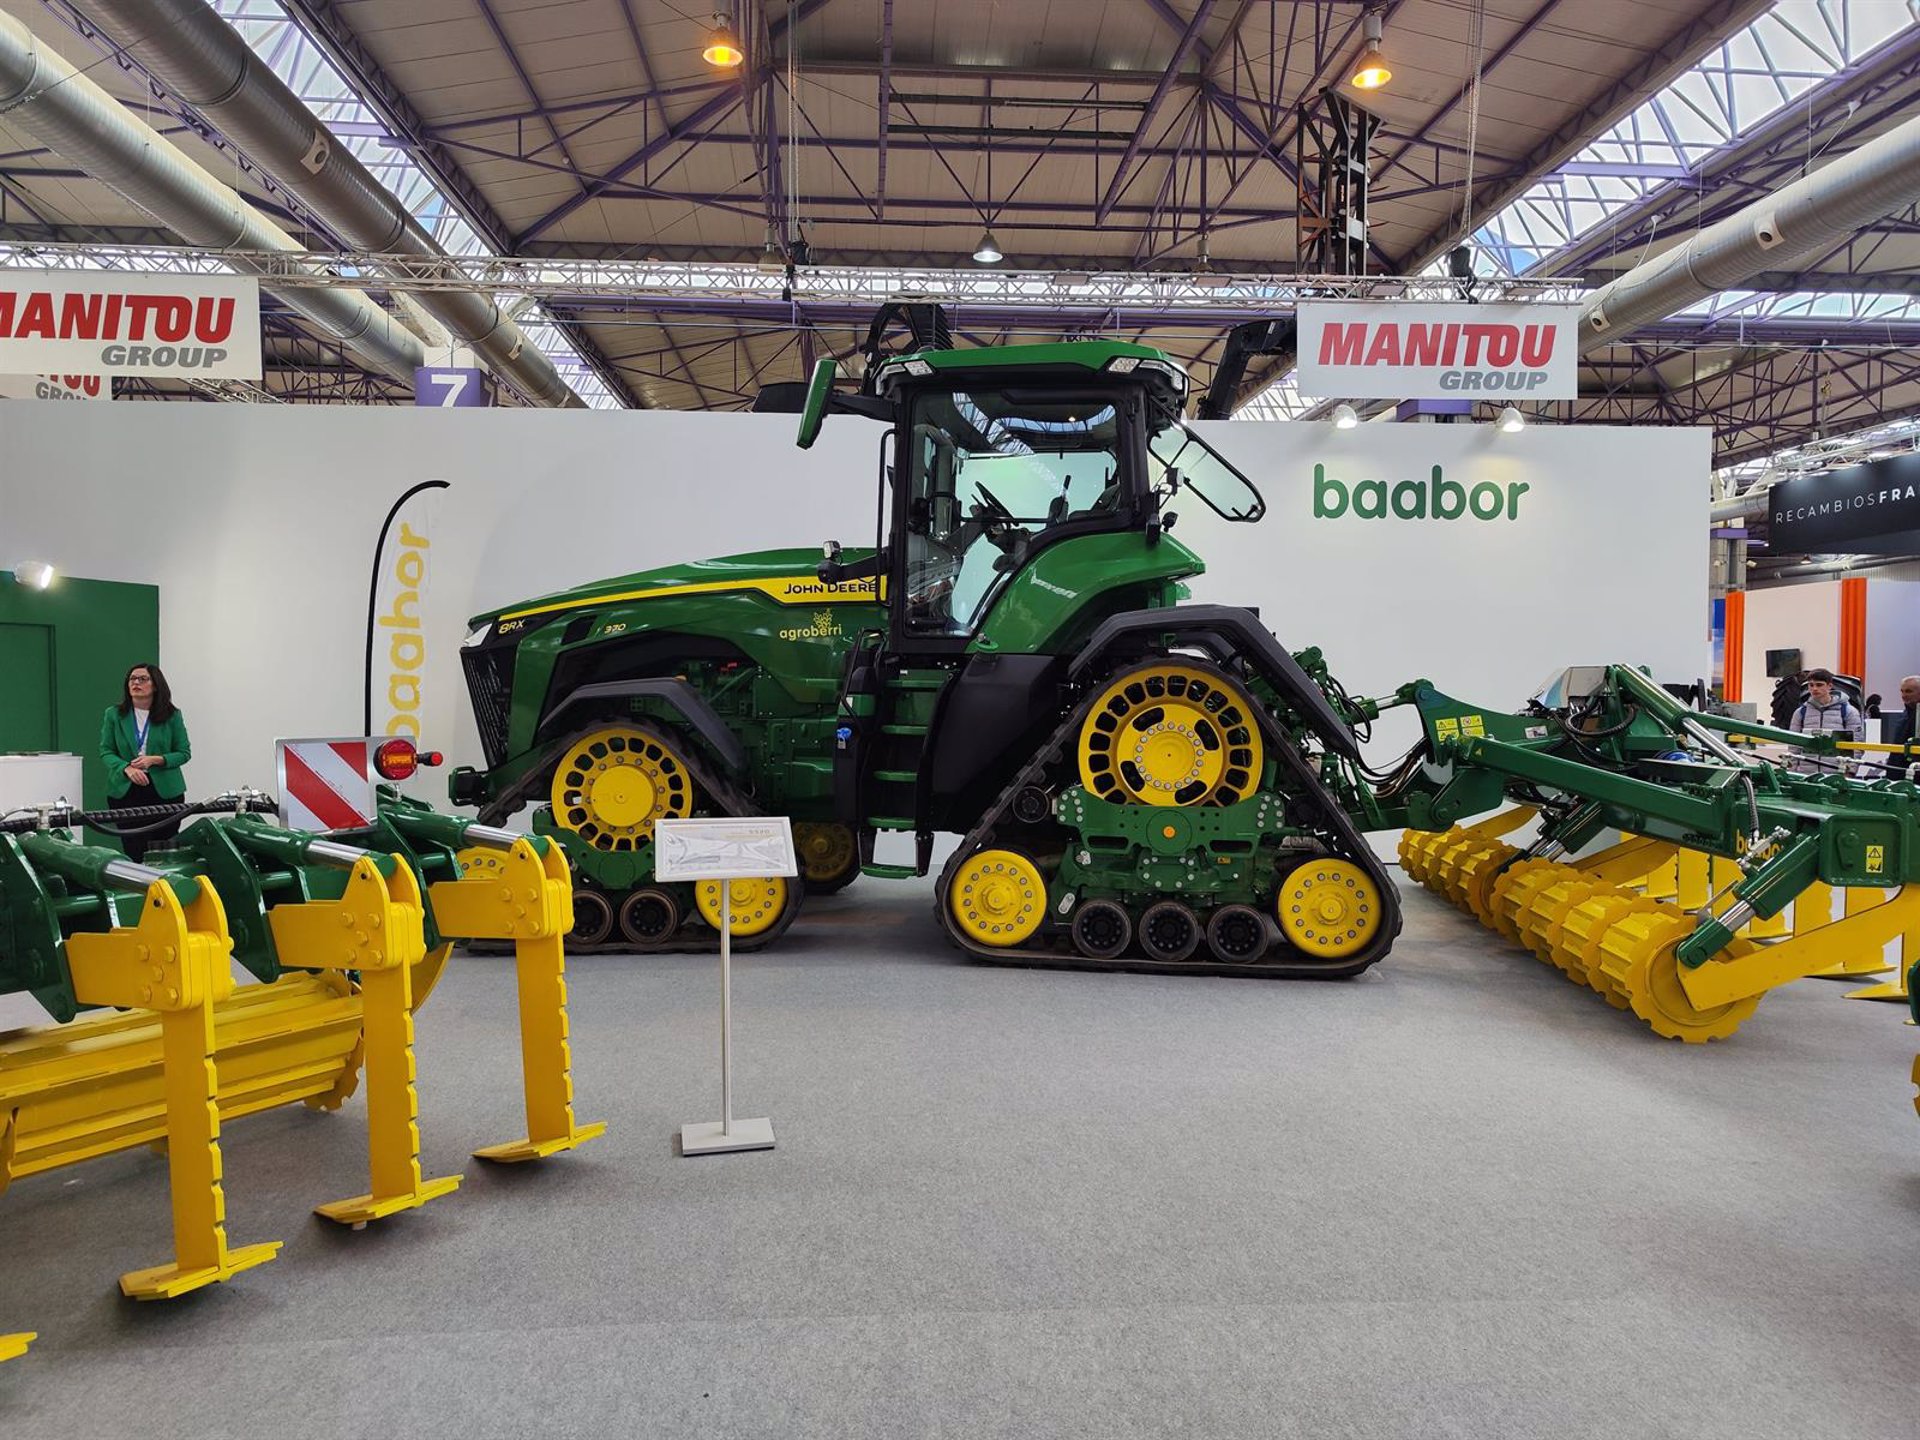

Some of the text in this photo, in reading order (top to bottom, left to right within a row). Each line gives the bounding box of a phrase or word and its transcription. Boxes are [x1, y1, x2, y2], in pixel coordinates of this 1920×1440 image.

[101, 345, 228, 368] GROUP
[1318, 323, 1557, 368] MANITOU
[431, 373, 468, 407] 7
[1439, 371, 1548, 391] GROUP
[1313, 463, 1530, 521] baabor
[1775, 485, 1916, 525] RECAMBIOSFRA
[499, 619, 525, 634] 8RX
[779, 624, 842, 641] agroberri
